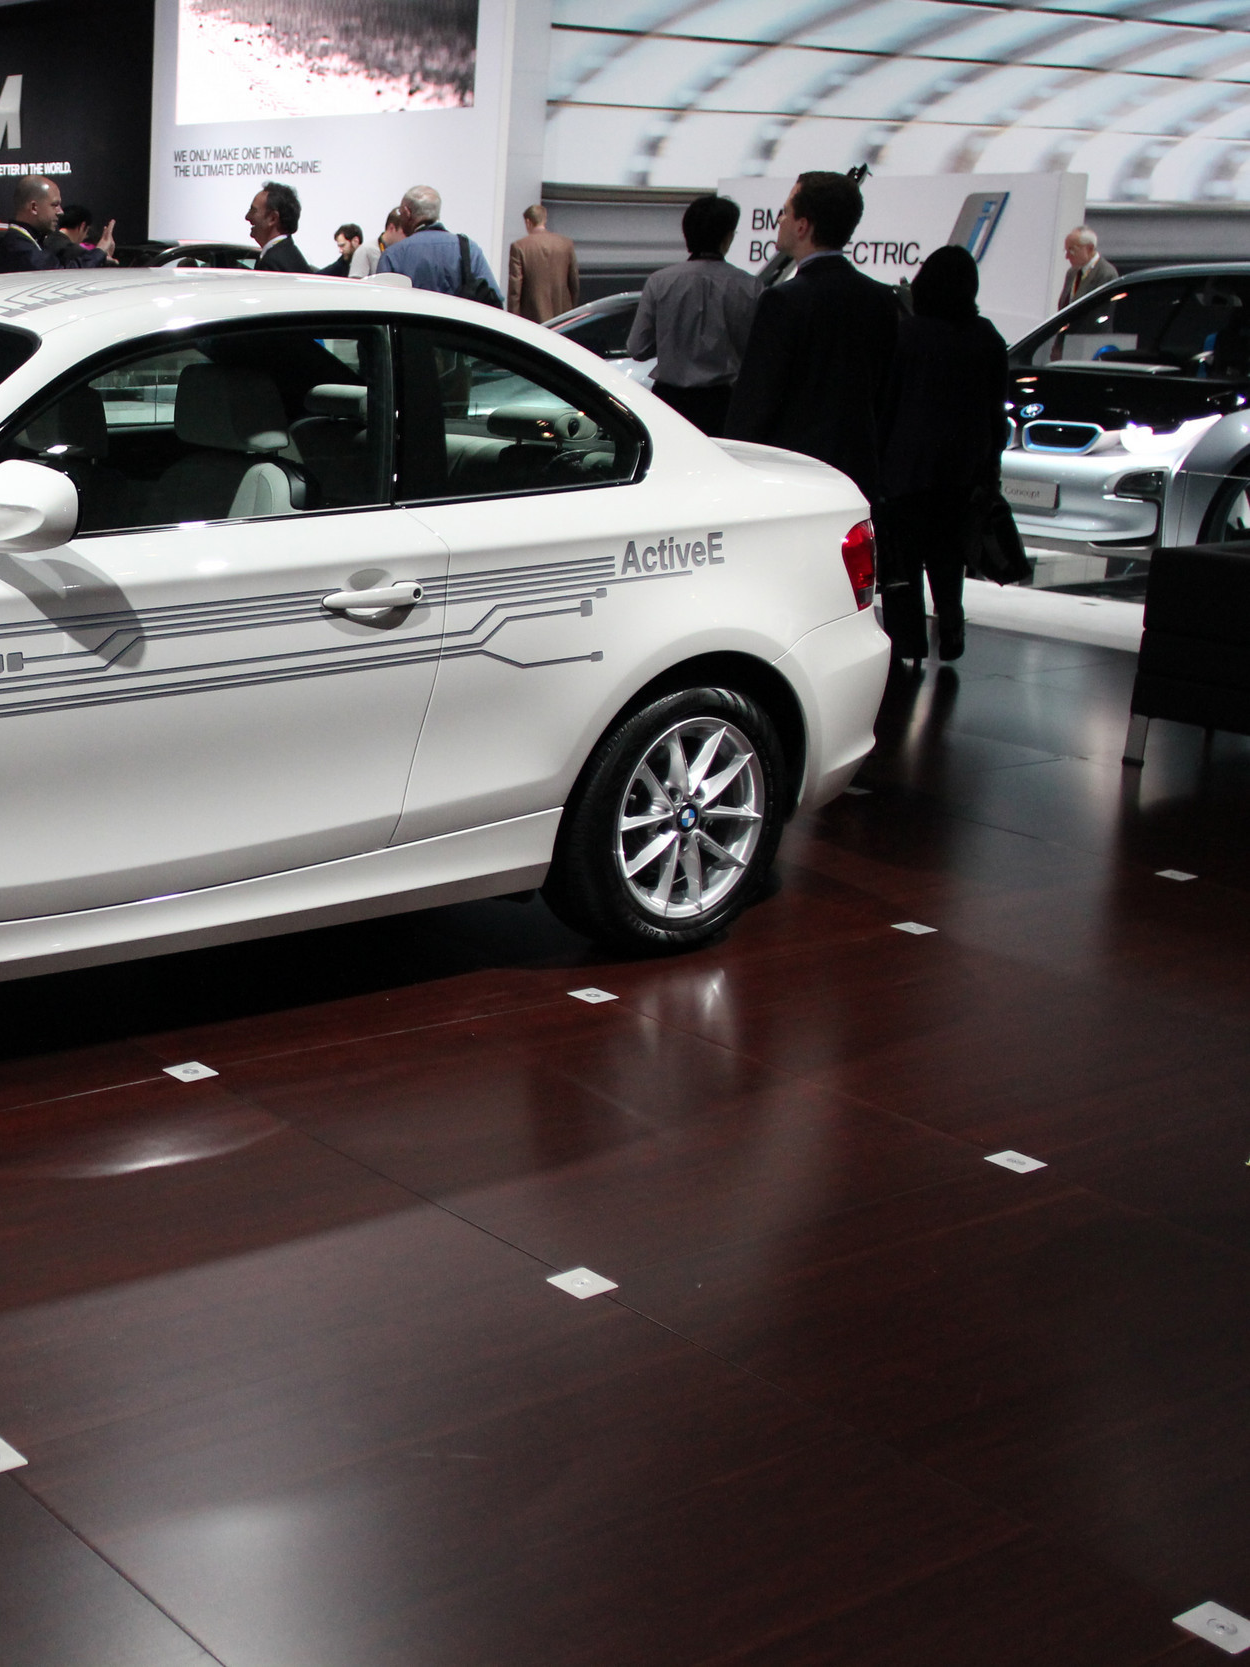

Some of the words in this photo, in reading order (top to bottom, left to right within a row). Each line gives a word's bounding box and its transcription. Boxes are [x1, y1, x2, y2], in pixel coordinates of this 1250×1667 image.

[174, 151, 187, 162] WE
[189, 149, 212, 162] ONLY
[214, 148, 240, 161] MAKE
[241, 147, 261, 160] ONE
[20, 163, 28, 175] IN
[29, 162, 44, 175] THE
[44, 161, 72, 174] WORLD.
[174, 165, 191, 177] THE
[193, 163, 234, 177] ULTIMATE
[236, 162, 273, 176] DRIVING
[751, 208, 786, 230] BM
[749, 240, 778, 262] BO
[621, 531, 725, 575] ActiveE
